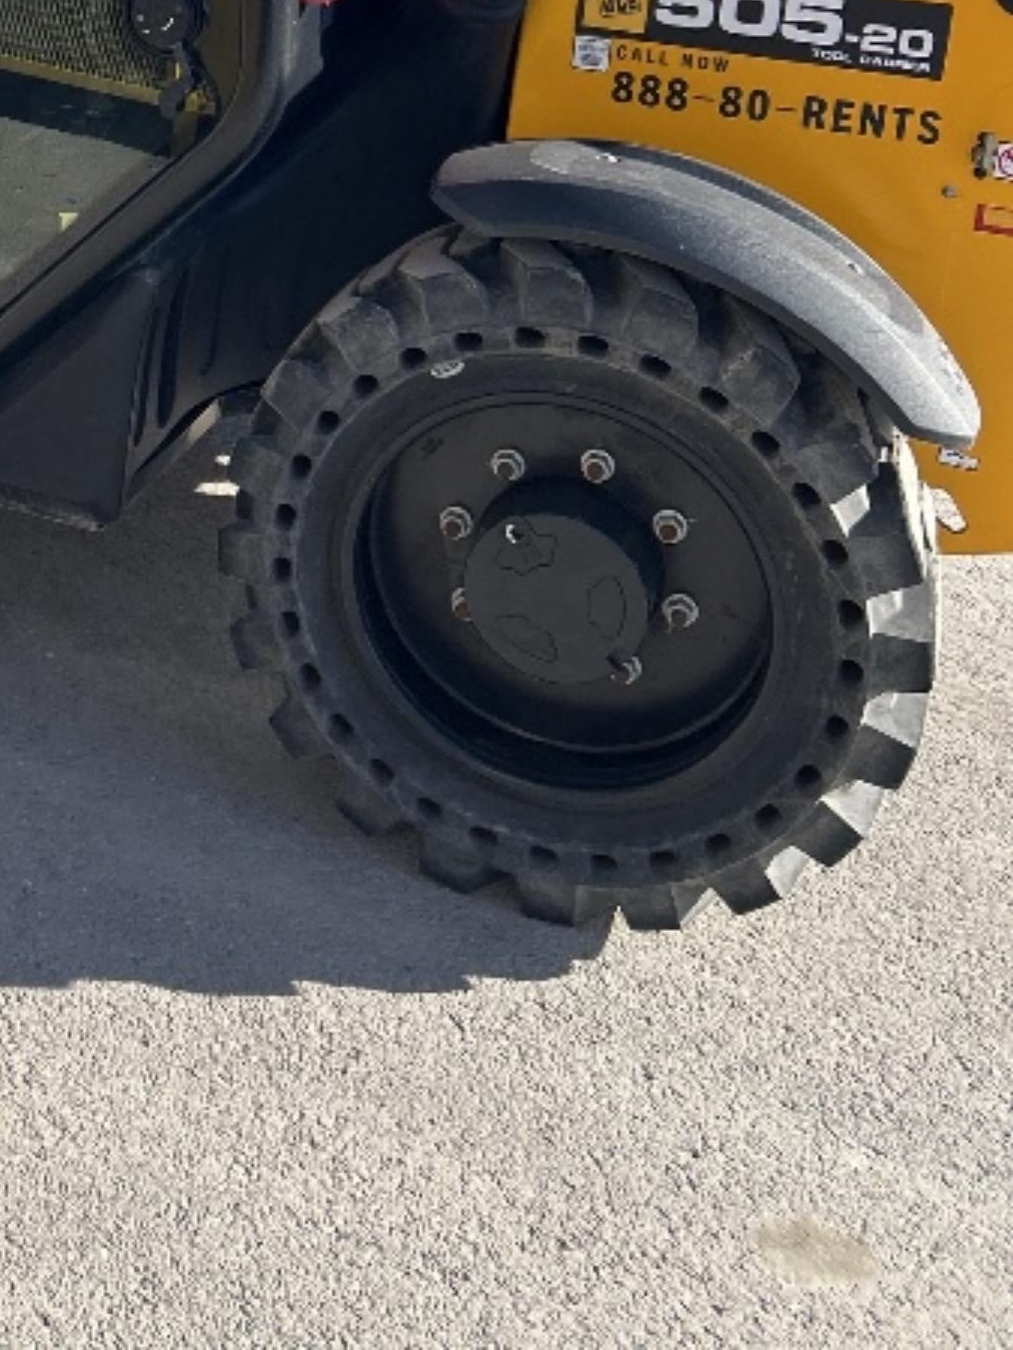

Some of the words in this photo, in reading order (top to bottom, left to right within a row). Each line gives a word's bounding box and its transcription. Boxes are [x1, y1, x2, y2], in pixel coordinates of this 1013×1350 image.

[616, 44, 669, 68] CALL
[682, 53, 731, 73] NOW
[611, 71, 943, 146] 888-80-RENTS
